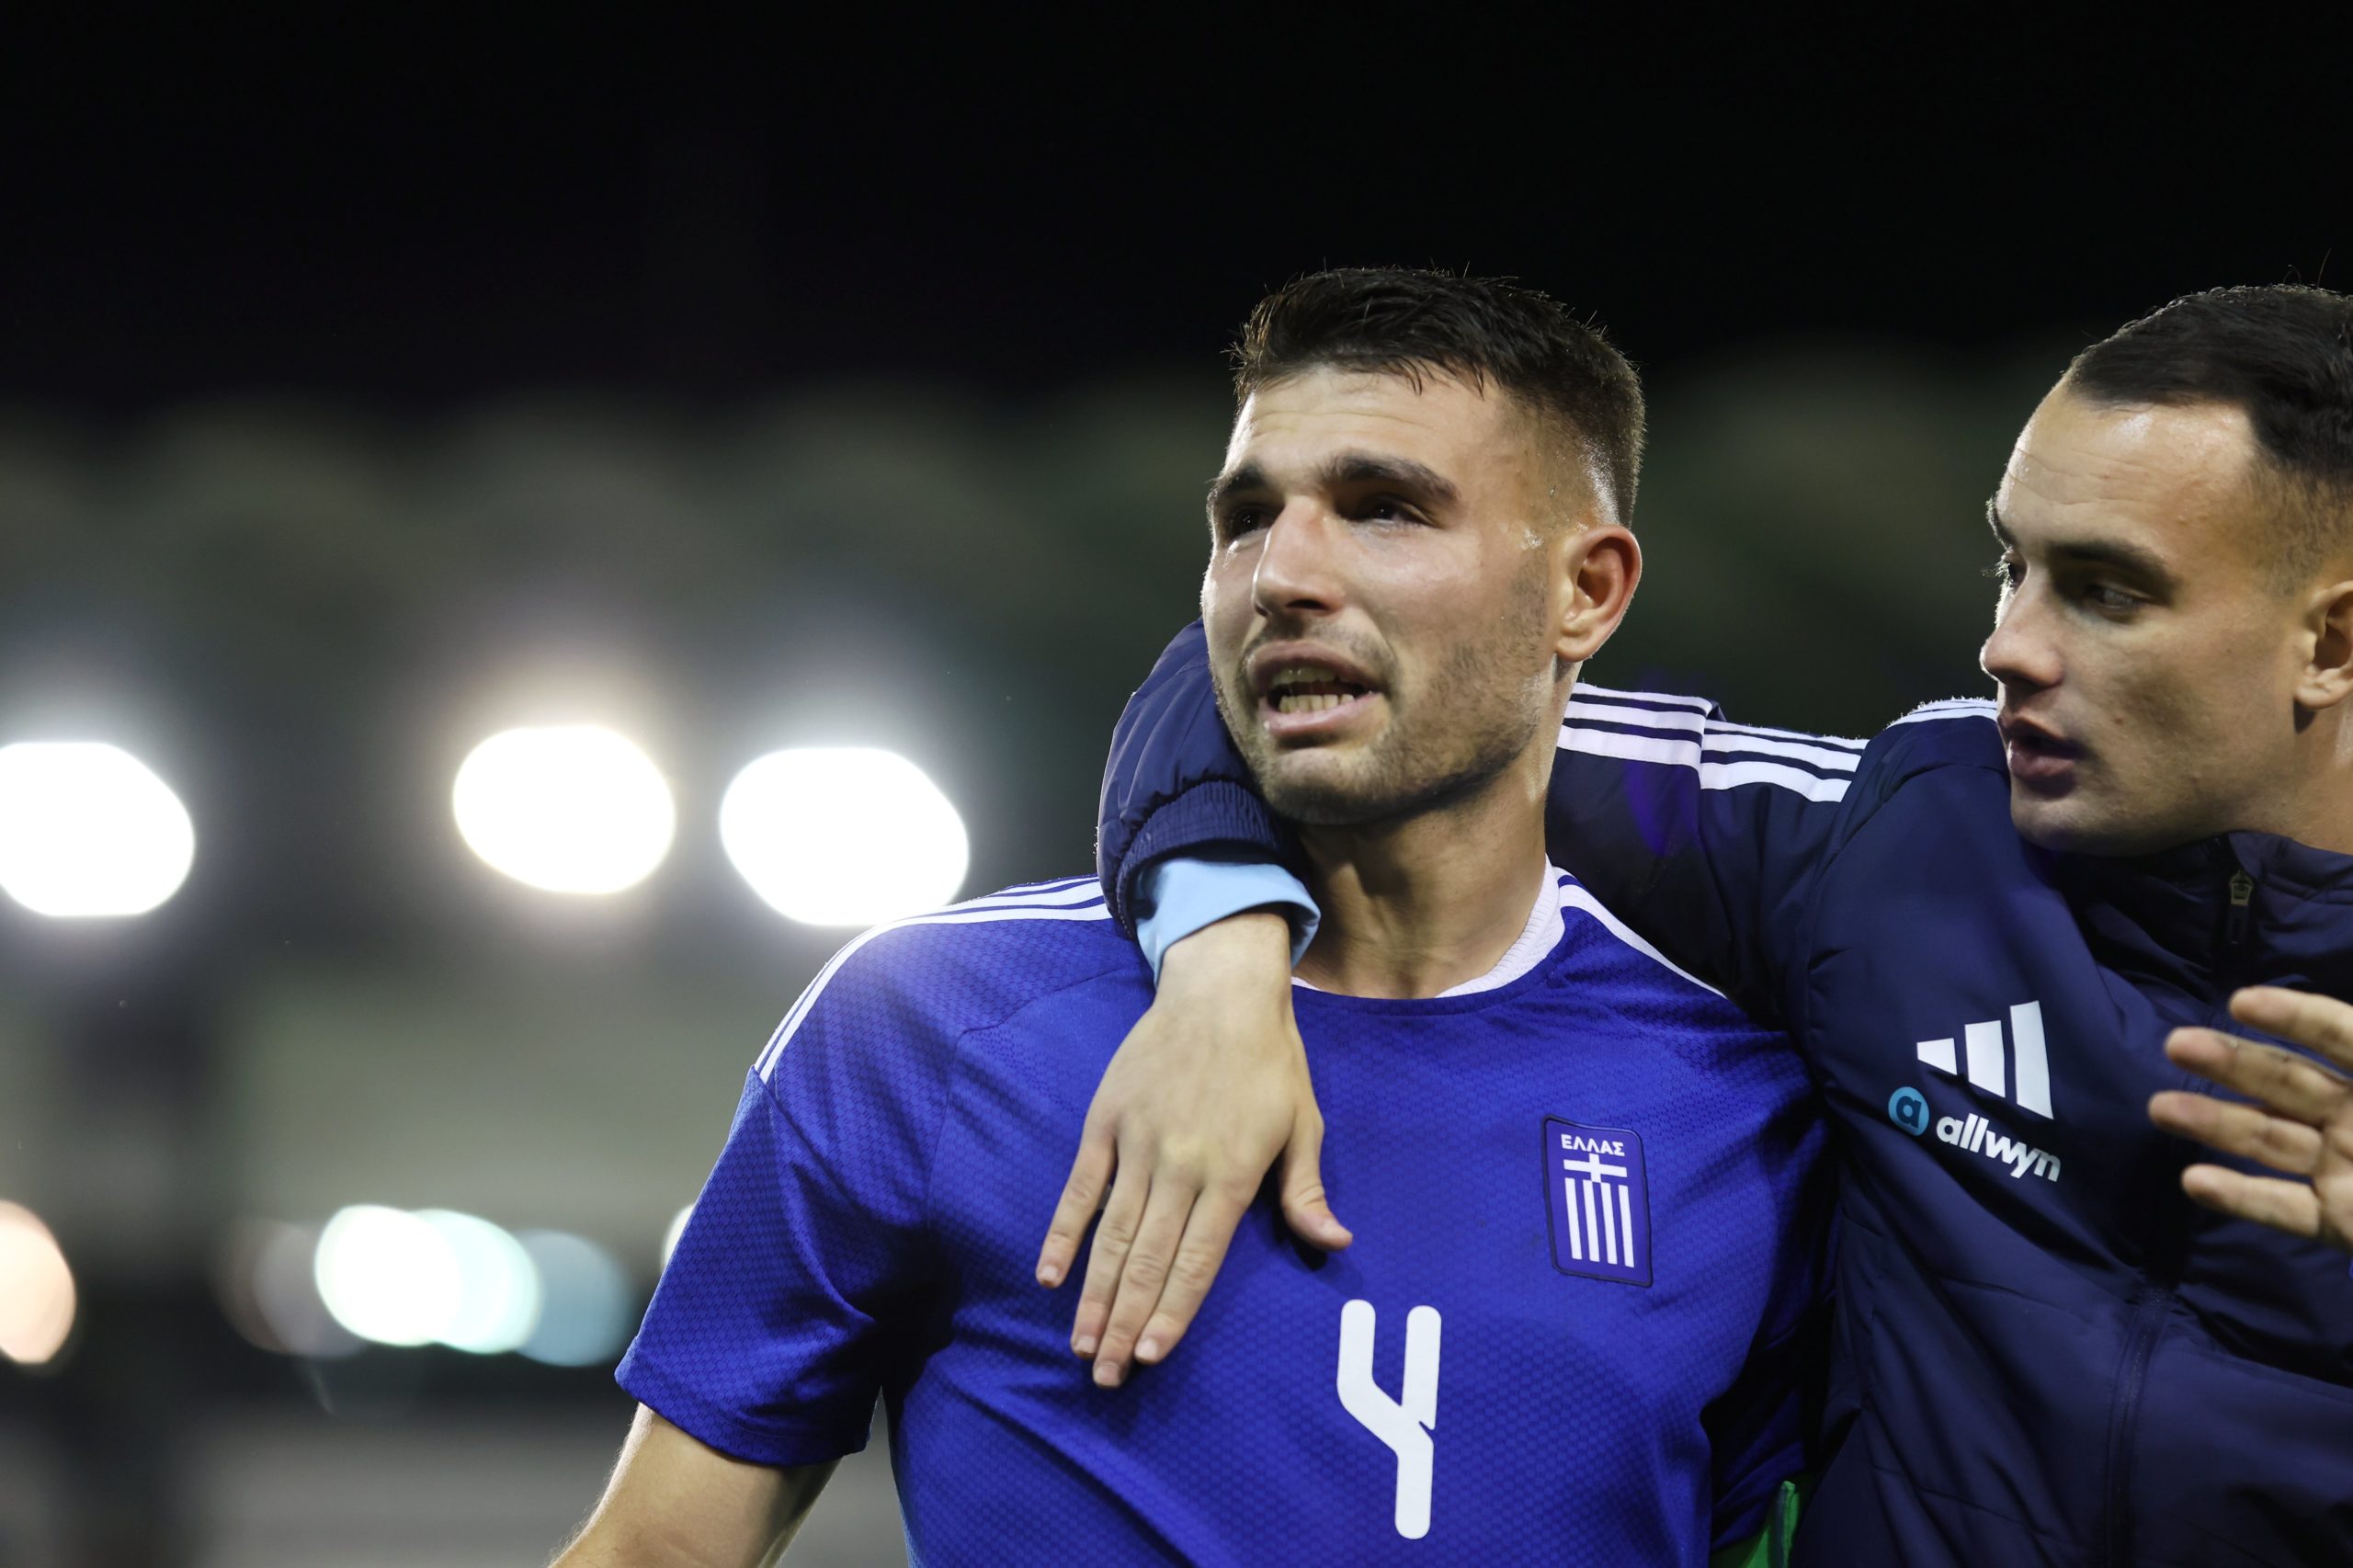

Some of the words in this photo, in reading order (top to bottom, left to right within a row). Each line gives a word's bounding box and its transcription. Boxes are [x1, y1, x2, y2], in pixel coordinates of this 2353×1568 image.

[1561, 1133, 1625, 1156] ΕΛΛΑΣ
[1936, 1112, 2061, 1182] allwyn
[1336, 1299, 1441, 1540] 4
